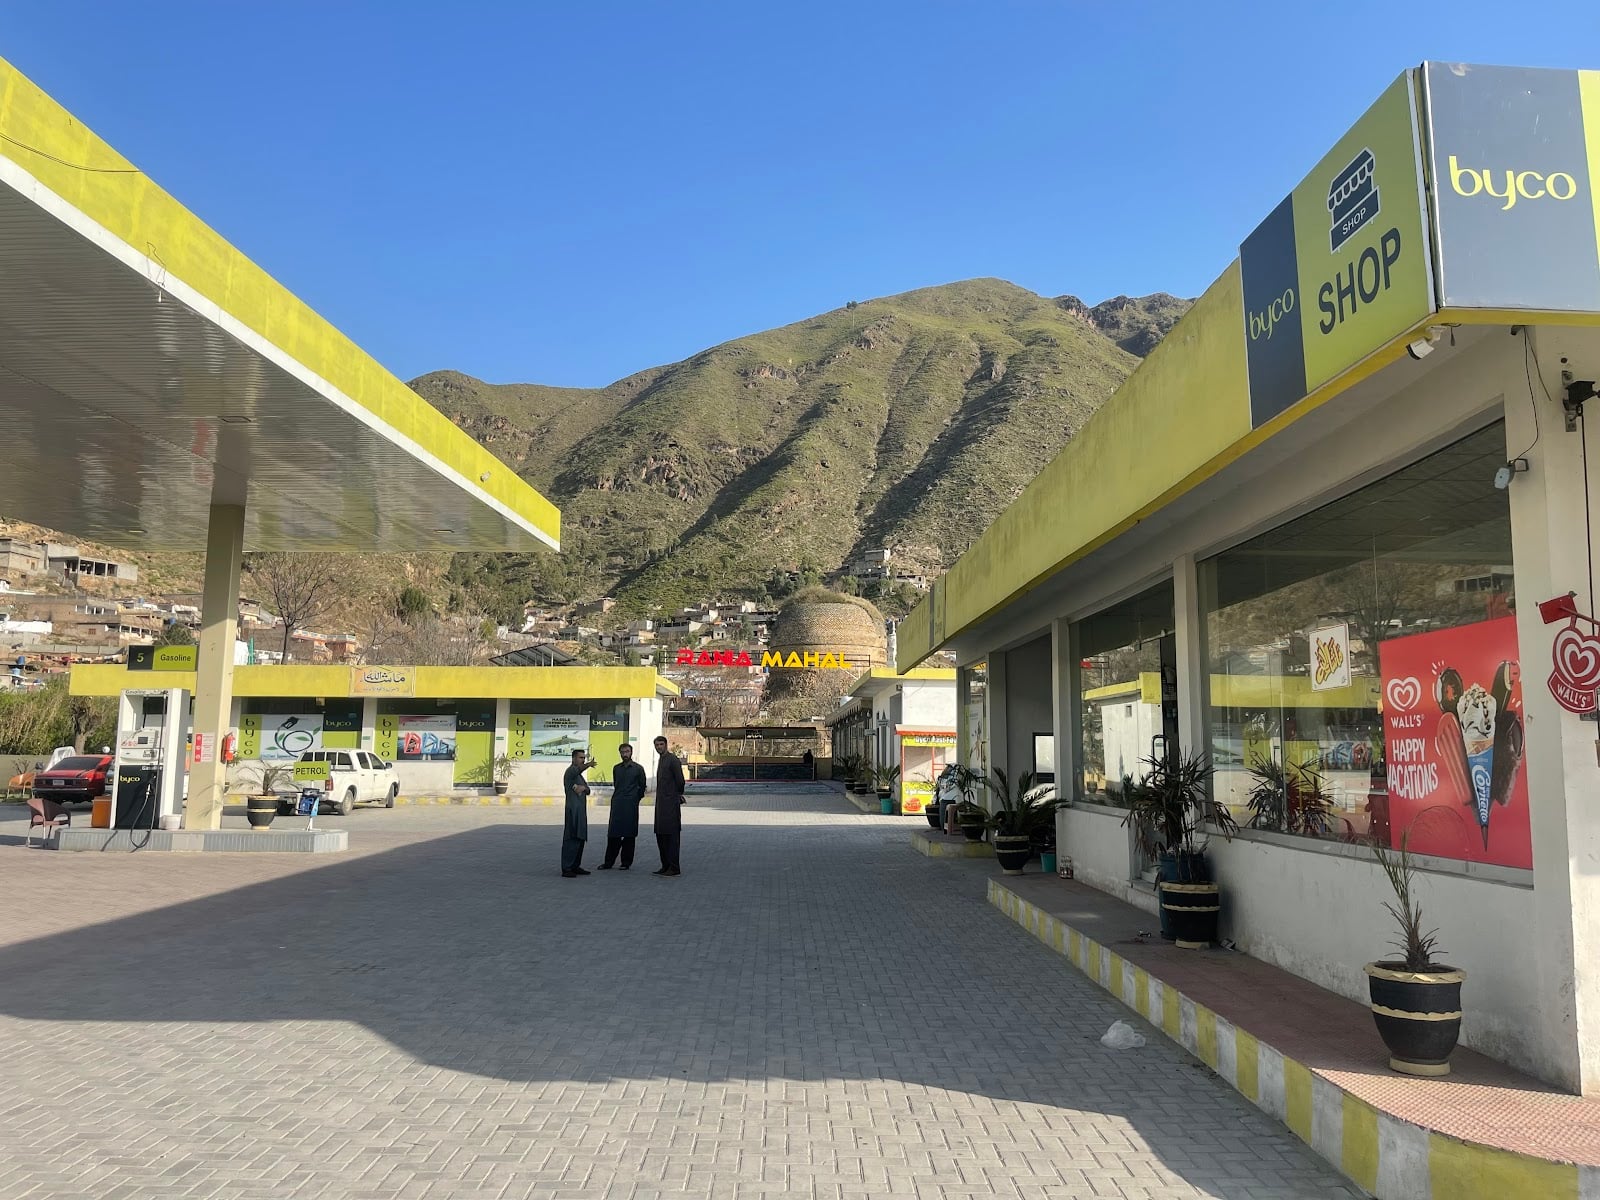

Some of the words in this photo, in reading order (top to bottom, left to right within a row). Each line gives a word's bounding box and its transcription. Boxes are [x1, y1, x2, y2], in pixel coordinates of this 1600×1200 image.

[1448, 155, 1577, 211] byco
[1342, 207, 1367, 236] SHOP
[1318, 227, 1401, 335] SHOP
[1249, 288, 1295, 341] byco
[136, 652, 145, 663] 5
[160, 653, 192, 662] Gasoline
[676, 647, 753, 667] RANIA
[761, 650, 853, 669] MAHAL
[1557, 683, 1587, 708] WALL'S
[325, 720, 352, 728] byco
[459, 720, 485, 728] byco
[593, 719, 618, 728] byco
[1391, 715, 1421, 728] WALL'S
[243, 718, 255, 755] byco
[381, 718, 391, 757] byco
[515, 718, 526, 756] byco
[1392, 738, 1425, 761] HAPPY
[120, 775, 140, 783] byco
[295, 767, 327, 775] PETROL
